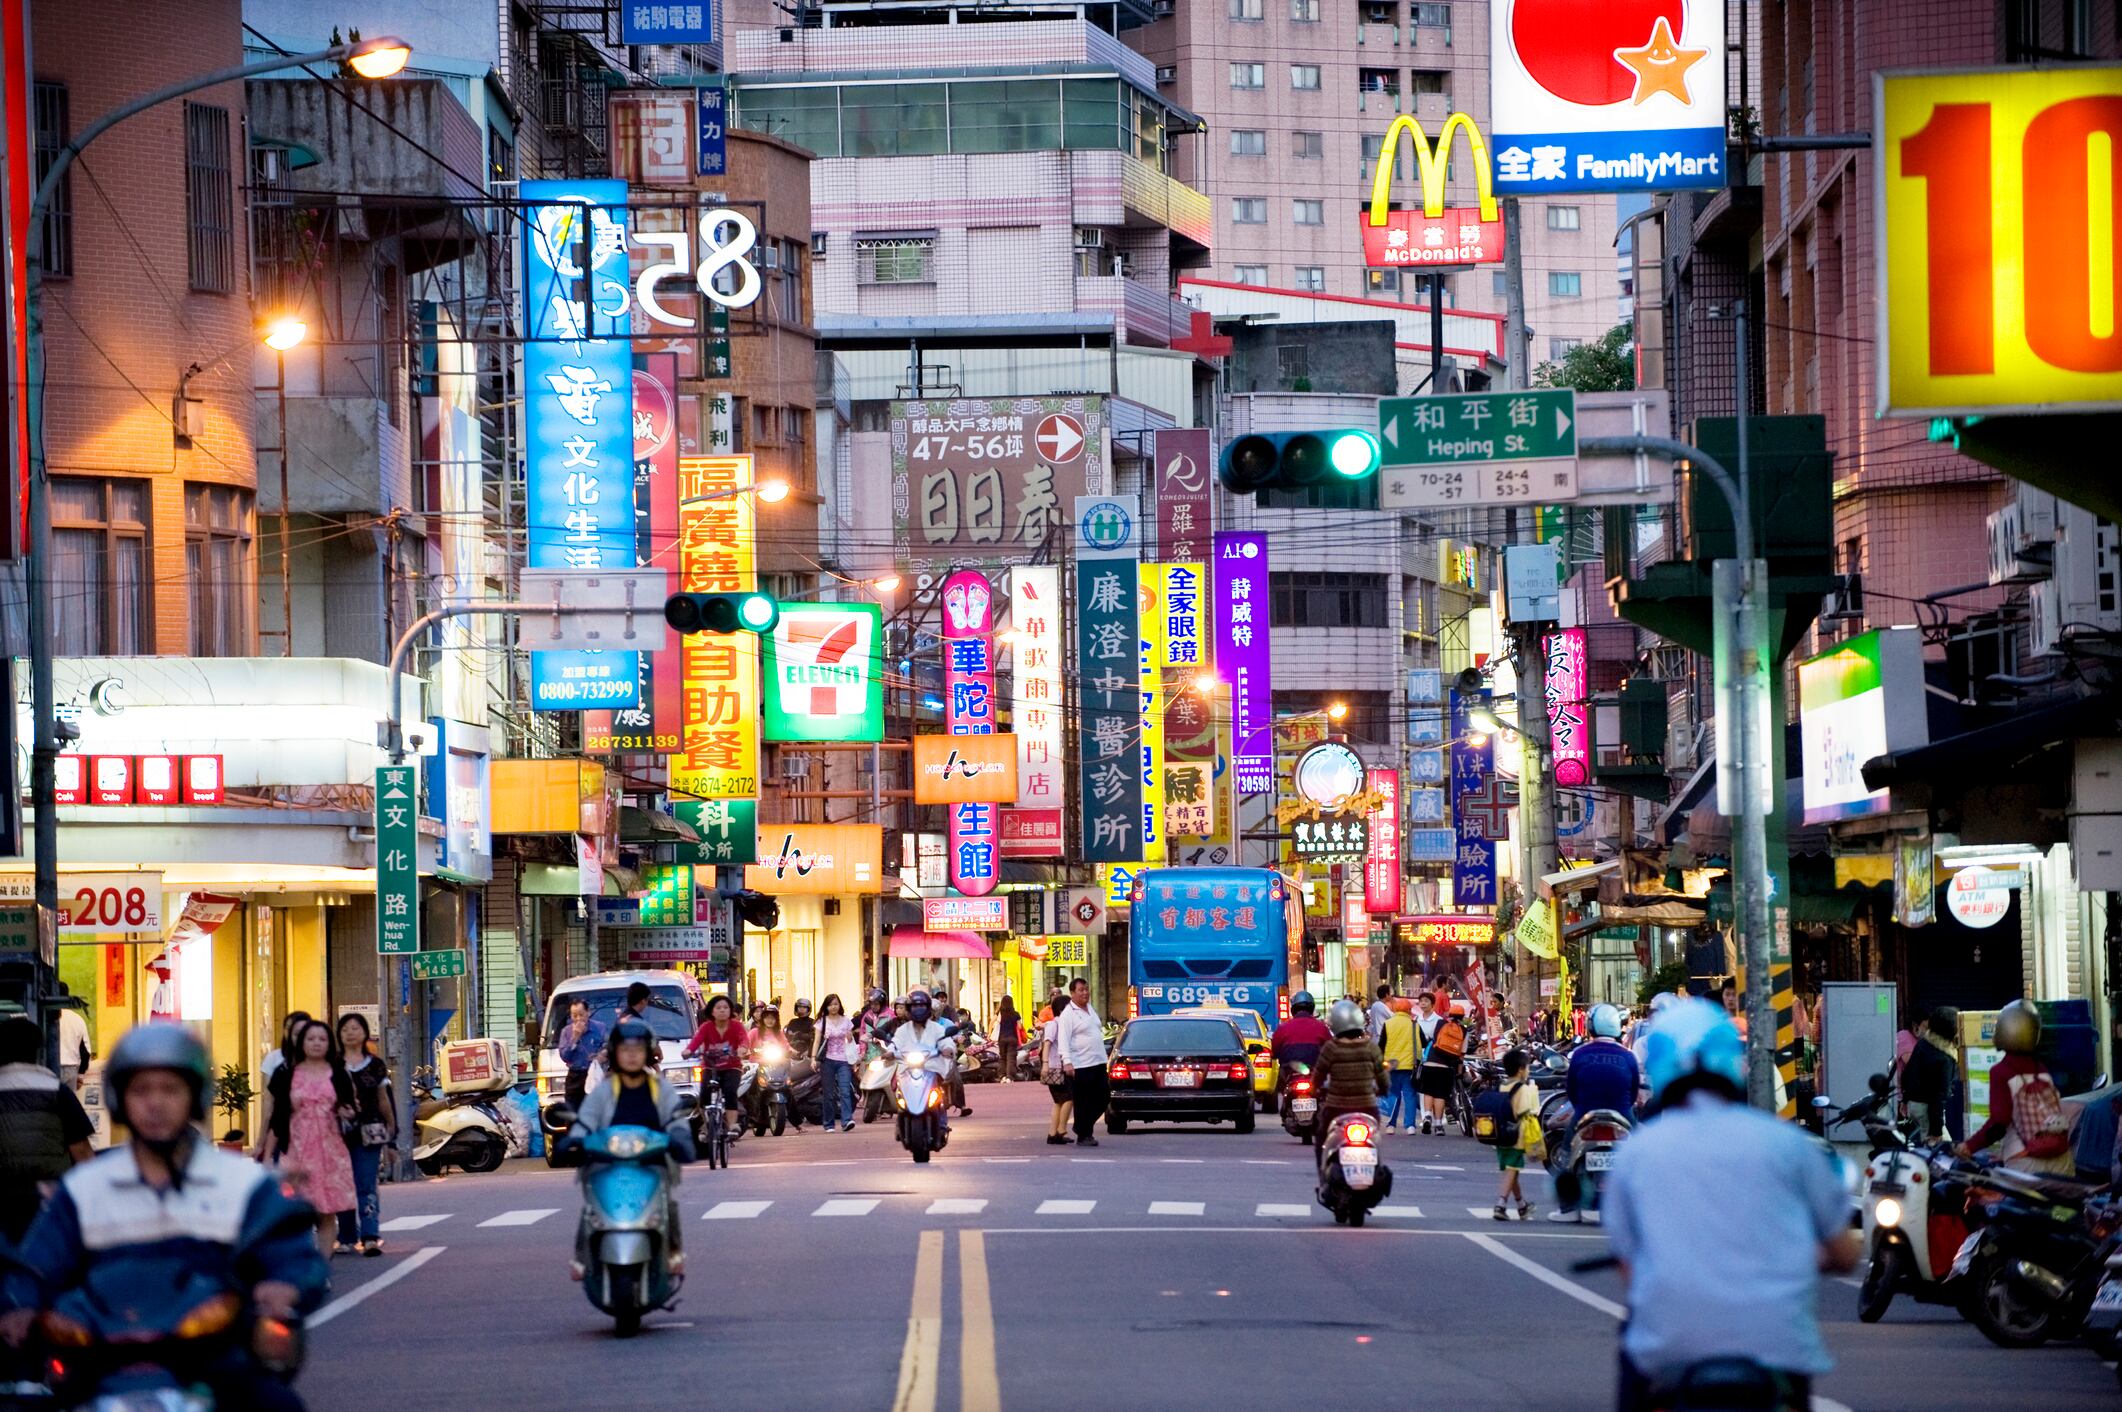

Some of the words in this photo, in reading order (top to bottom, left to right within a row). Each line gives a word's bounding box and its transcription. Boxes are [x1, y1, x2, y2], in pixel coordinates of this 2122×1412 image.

[702, 91, 722, 170] 新力牌
[1497, 146, 1566, 181] 全家
[1577, 153, 1719, 182] FamilyMart
[1387, 225, 1481, 247] 麥當勞
[1901, 95, 2122, 376] 10
[1385, 246, 1483, 263] McDonald's
[1414, 399, 1539, 433] 和平街
[1428, 437, 1494, 459] Heping
[1504, 433, 1530, 452] St.
[1420, 472, 1462, 485] 70-24
[1495, 469, 1529, 482] 24-4
[1439, 486, 1462, 499] -57
[1496, 484, 1529, 497] 53-3
[680, 463, 743, 770] 福廣燒自助餐
[1168, 567, 1198, 663] 全家眼鏡
[1231, 578, 1252, 647] 詩威特
[788, 621, 857, 663] 7
[539, 681, 633, 700] 0800-732999
[1086, 571, 1133, 854] 廉澄中醫診所
[588, 736, 679, 748] 26731139
[384, 770, 406, 786] 東
[693, 777, 755, 794] 2674-2172
[55, 791, 75, 801] Café
[101, 792, 121, 801] Cake
[150, 792, 164, 801] Tea
[695, 801, 736, 839] 科
[1176, 806, 1190, 834] 精品
[384, 805, 409, 915] 文化路
[698, 841, 733, 861] 診所
[1959, 891, 1986, 902] ATM
[945, 901, 1002, 915] 請上二樓
[1158, 904, 1259, 931] 首都客運
[384, 920, 411, 931] Wen-
[384, 931, 404, 940] hua
[384, 940, 401, 951] Rd.
[1143, 988, 1162, 998] ETC
[1167, 985, 1250, 1003] 689FG
